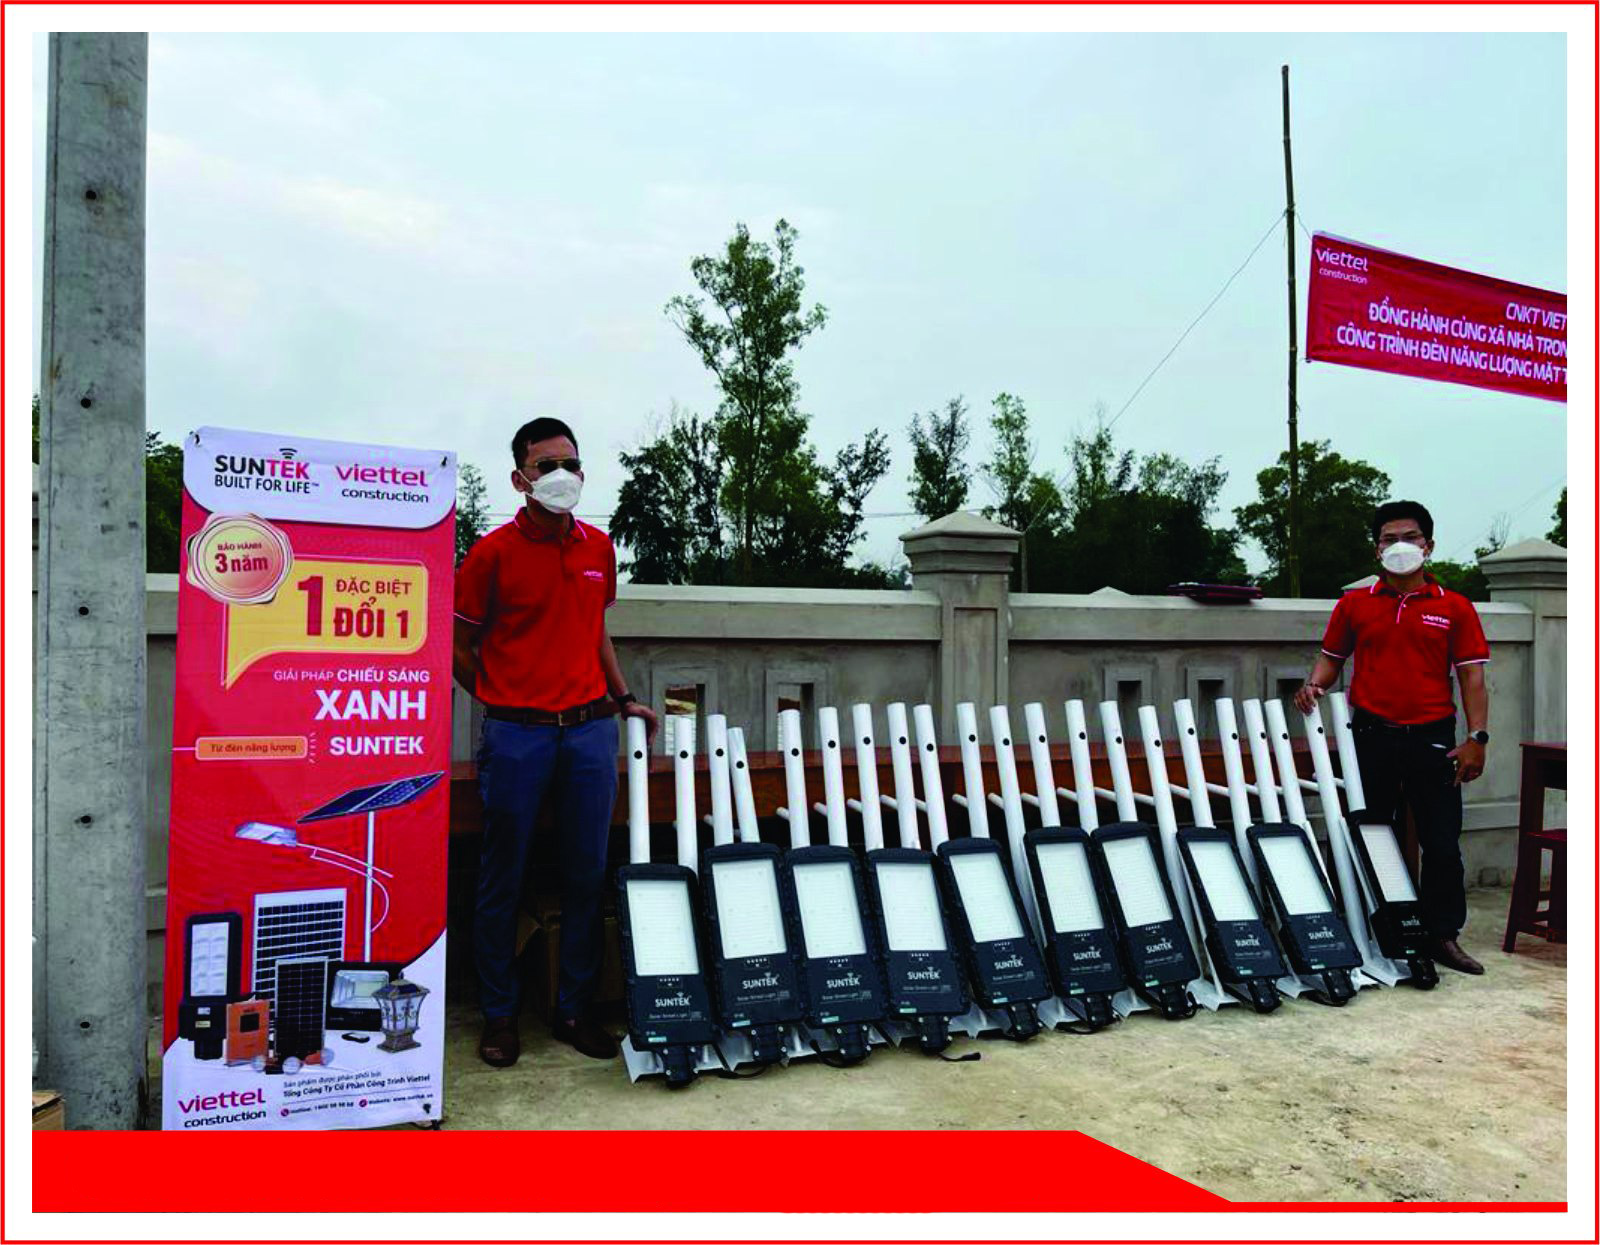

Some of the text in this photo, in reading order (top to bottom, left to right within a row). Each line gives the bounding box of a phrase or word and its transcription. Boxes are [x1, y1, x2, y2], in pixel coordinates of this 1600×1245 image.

[1316, 247, 1368, 272] viettel
[1318, 267, 1368, 285] construction
[1506, 302, 1567, 331] CNKT VIET
[1410, 307, 1450, 335] HÀNH
[1488, 325, 1505, 346] XÃ
[1506, 329, 1534, 351] NHÀ
[1336, 322, 1376, 350] CÔNG
[1377, 331, 1419, 358] TRÌNH
[1420, 338, 1450, 363] ĐÈN
[1451, 345, 1488, 370] NĂNG
[1489, 354, 1532, 378] LƯỢNG
[1533, 361, 1562, 385] MẶT
[214, 454, 311, 480] SUNTEK
[336, 464, 429, 487] viettel
[214, 475, 253, 489] BUILT
[255, 478, 282, 492] FOR
[341, 487, 429, 503] construction
[214, 552, 268, 573] 3 năm
[336, 576, 412, 598] ĐẶC BIỆT
[297, 575, 409, 639] 1 ĐỔI 1
[273, 665, 430, 683] GIẢI PHÁP CHIẾU SÁNG
[315, 689, 427, 720] XANH
[329, 735, 424, 755] SUNTEK
[1073, 951, 1102, 961] SUNTEK
[1145, 942, 1174, 954] SUNTEK
[993, 958, 1024, 970] SUNTEK
[742, 976, 779, 990] SUNTEK
[826, 977, 860, 989] SUNTEK
[907, 971, 940, 980] SUNTEK
[655, 997, 691, 1008] SUNTEK
[407, 1073, 430, 1083] Viettel
[177, 1088, 267, 1115] viettel
[183, 1109, 268, 1129] construction
